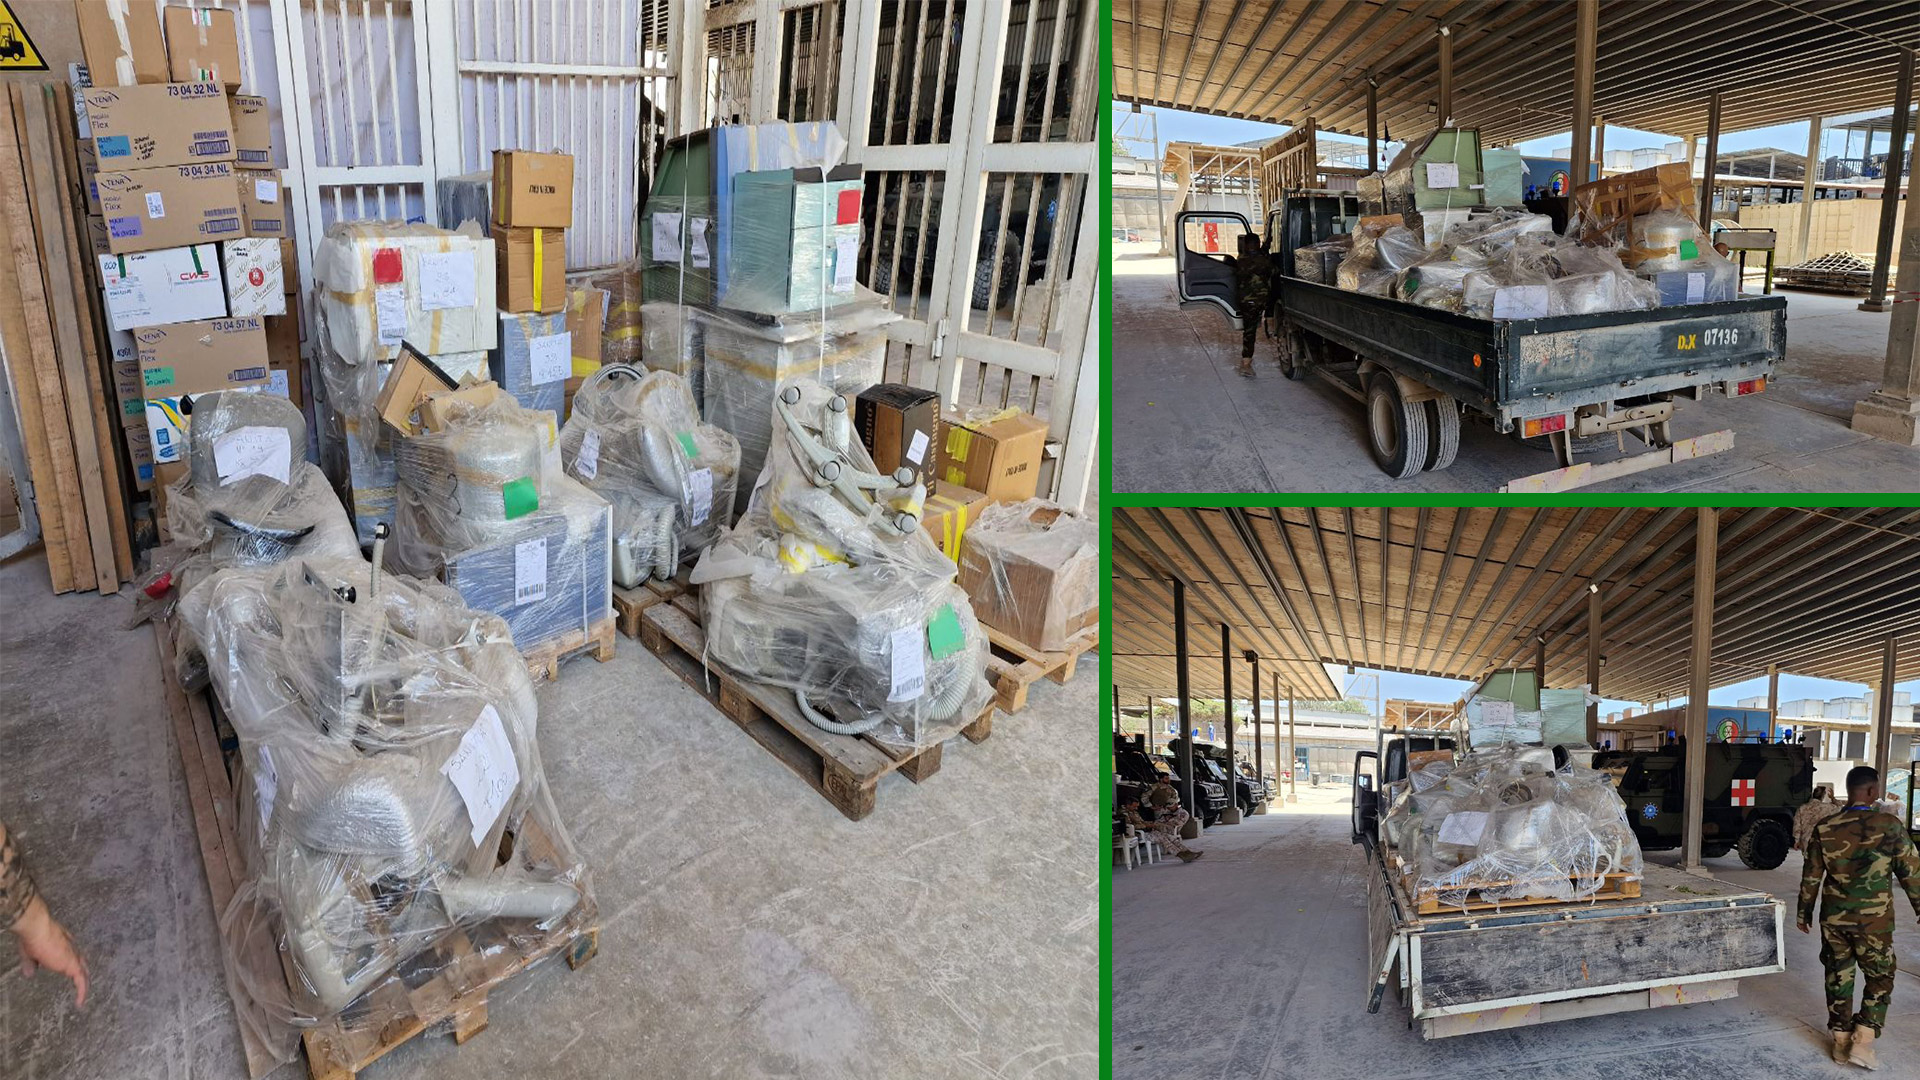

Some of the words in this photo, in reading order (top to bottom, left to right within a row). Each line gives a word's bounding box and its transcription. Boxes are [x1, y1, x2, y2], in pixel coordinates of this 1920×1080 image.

[167, 86, 179, 96] 73
[181, 85, 192, 95] 04
[193, 84, 204, 94] 32
[206, 83, 219, 93] NL
[92, 120, 109, 128] Flex
[179, 167, 190, 177] 73
[191, 166, 202, 175] 04
[204, 165, 215, 175] 34
[217, 163, 230, 173] NL
[104, 202, 121, 211] Flex
[180, 271, 210, 281] CWS
[212, 322, 222, 331] 73
[224, 321, 234, 330] 04
[236, 320, 245, 328] 57
[248, 319, 259, 327] NL
[1677, 333, 1697, 350] D.X
[1704, 328, 1739, 346] 07136
[141, 354, 156, 362] Flex
